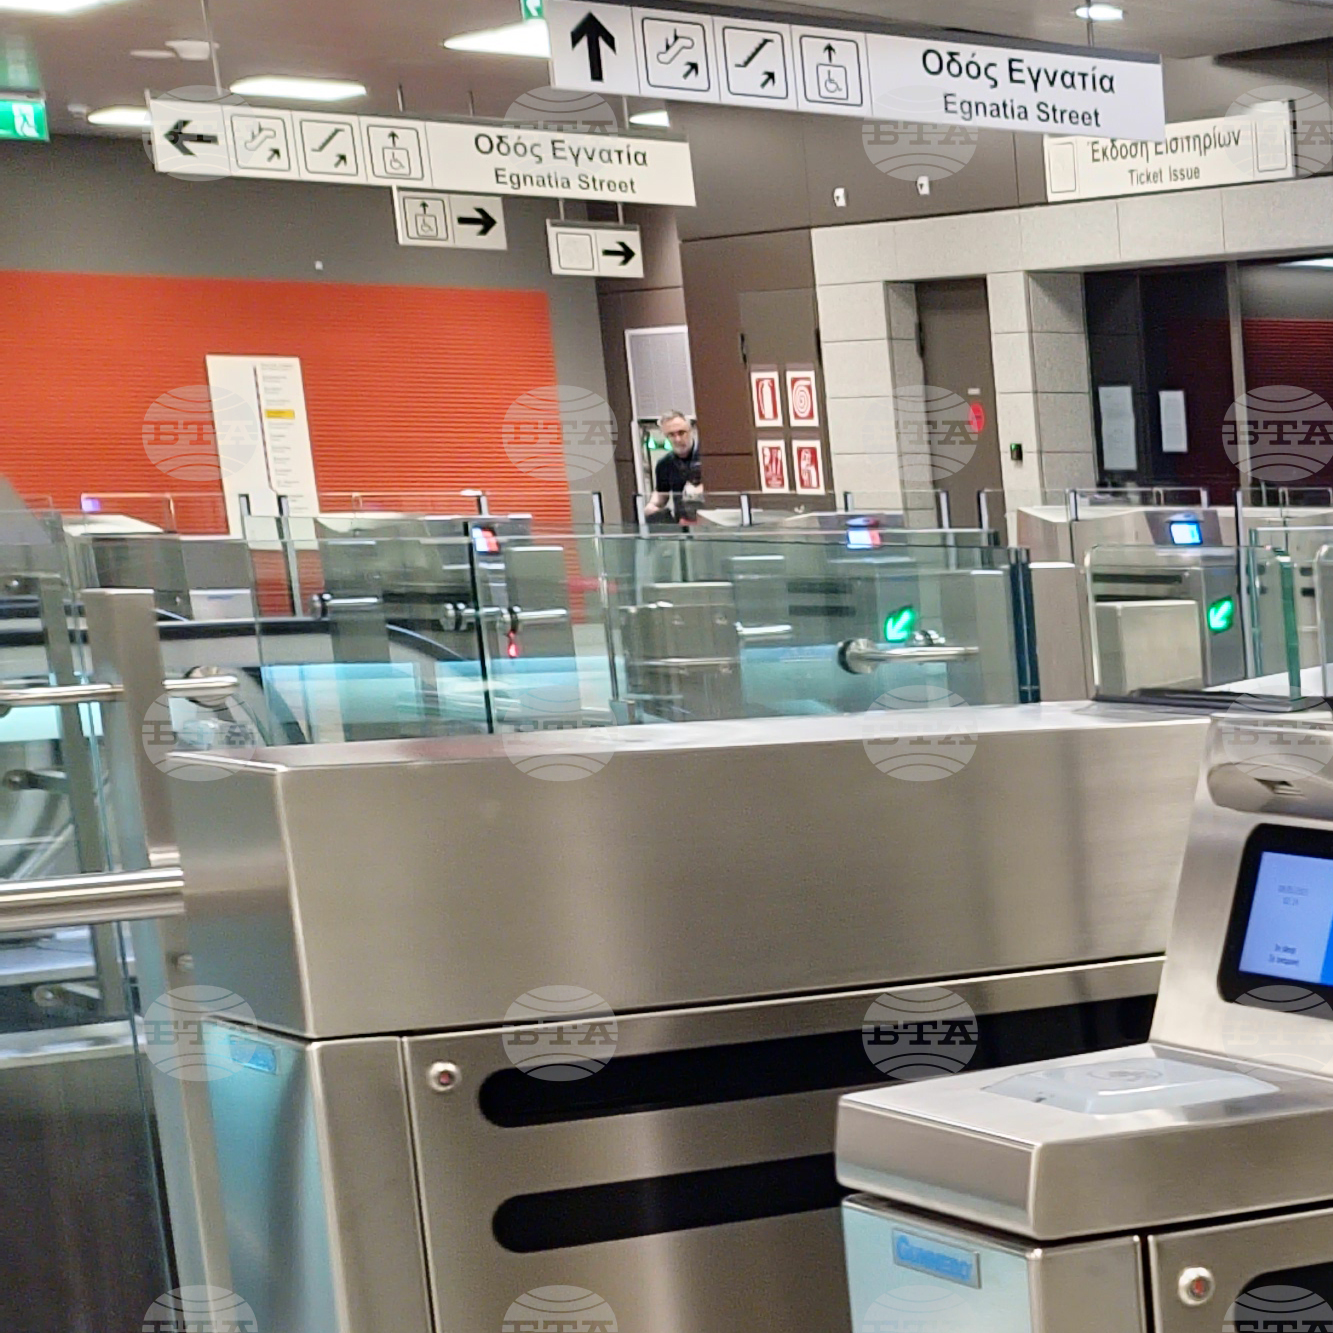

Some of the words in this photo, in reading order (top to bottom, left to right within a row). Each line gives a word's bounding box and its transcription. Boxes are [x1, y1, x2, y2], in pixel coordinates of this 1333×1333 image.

[922, 49, 998, 89] Οδός
[1008, 57, 1116, 94] Εγνατία
[943, 93, 1029, 121] Egnatia
[1037, 101, 1101, 128] Street
[474, 133, 543, 164] Οδός
[551, 139, 648, 167] Εγνατία
[494, 167, 571, 190] Egnatia
[578, 173, 637, 194] Street
[1128, 168, 1164, 186] Ticket
[1169, 165, 1201, 182] Issue
